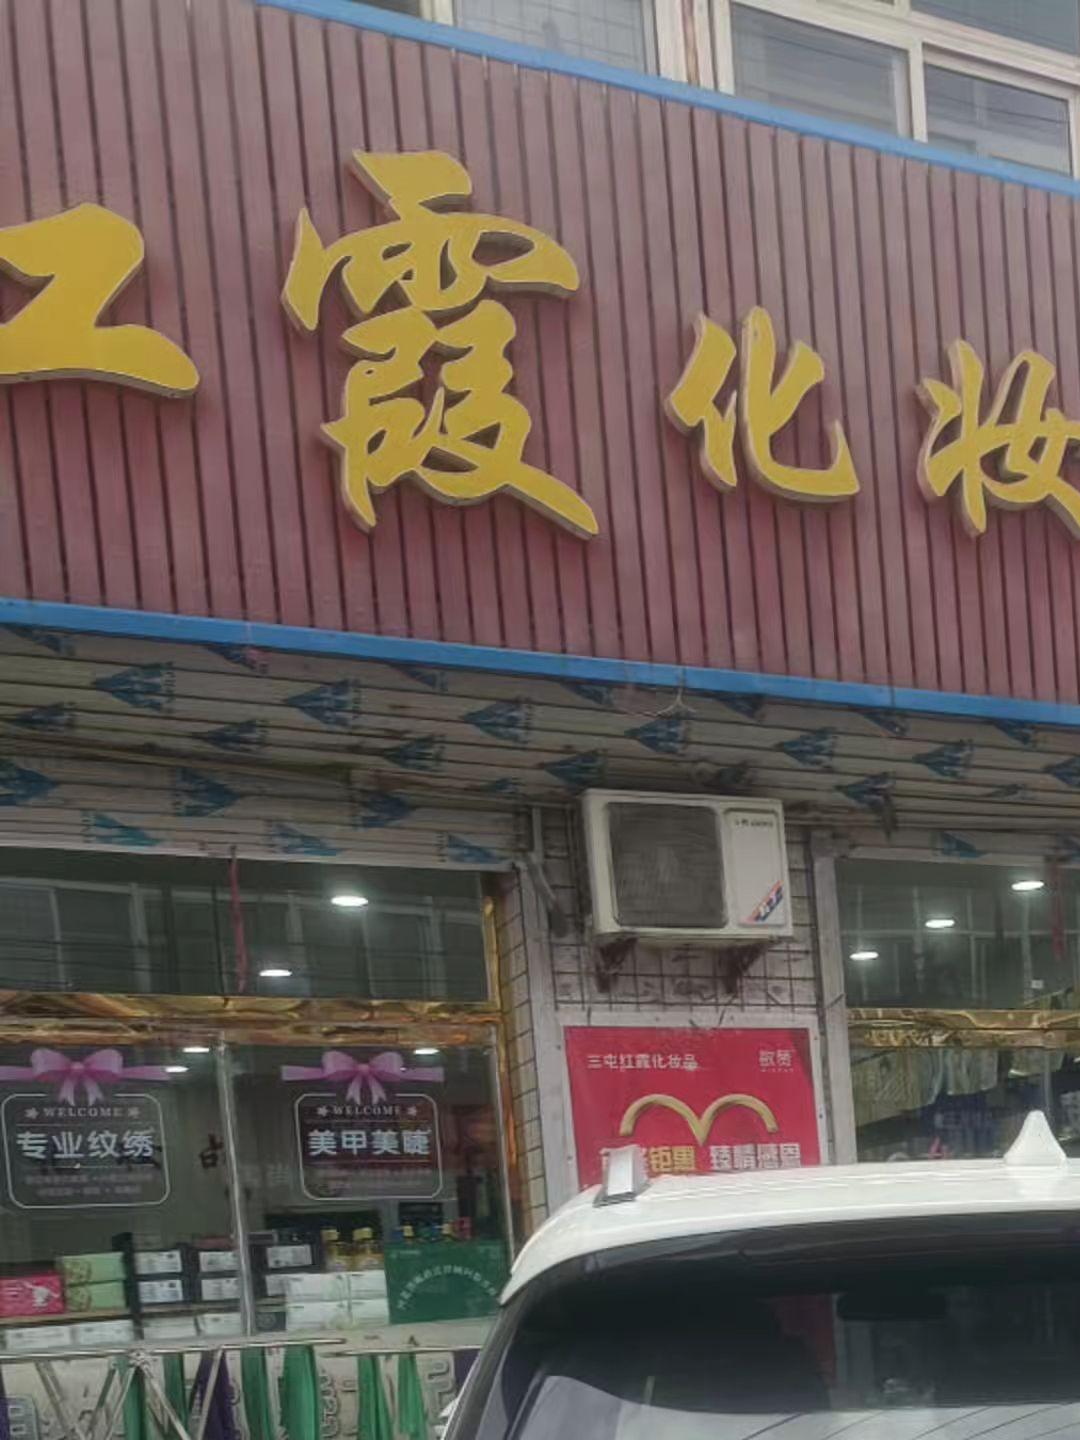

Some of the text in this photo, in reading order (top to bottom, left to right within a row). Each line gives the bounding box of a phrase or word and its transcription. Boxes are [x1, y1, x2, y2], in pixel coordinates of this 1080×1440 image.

[43, 1107, 123, 1118] WELCOME
[332, 1105, 401, 1116] WELCOME
[16, 1127, 155, 1160] 专业纹绣
[308, 1128, 433, 1157] 美甲美睫
